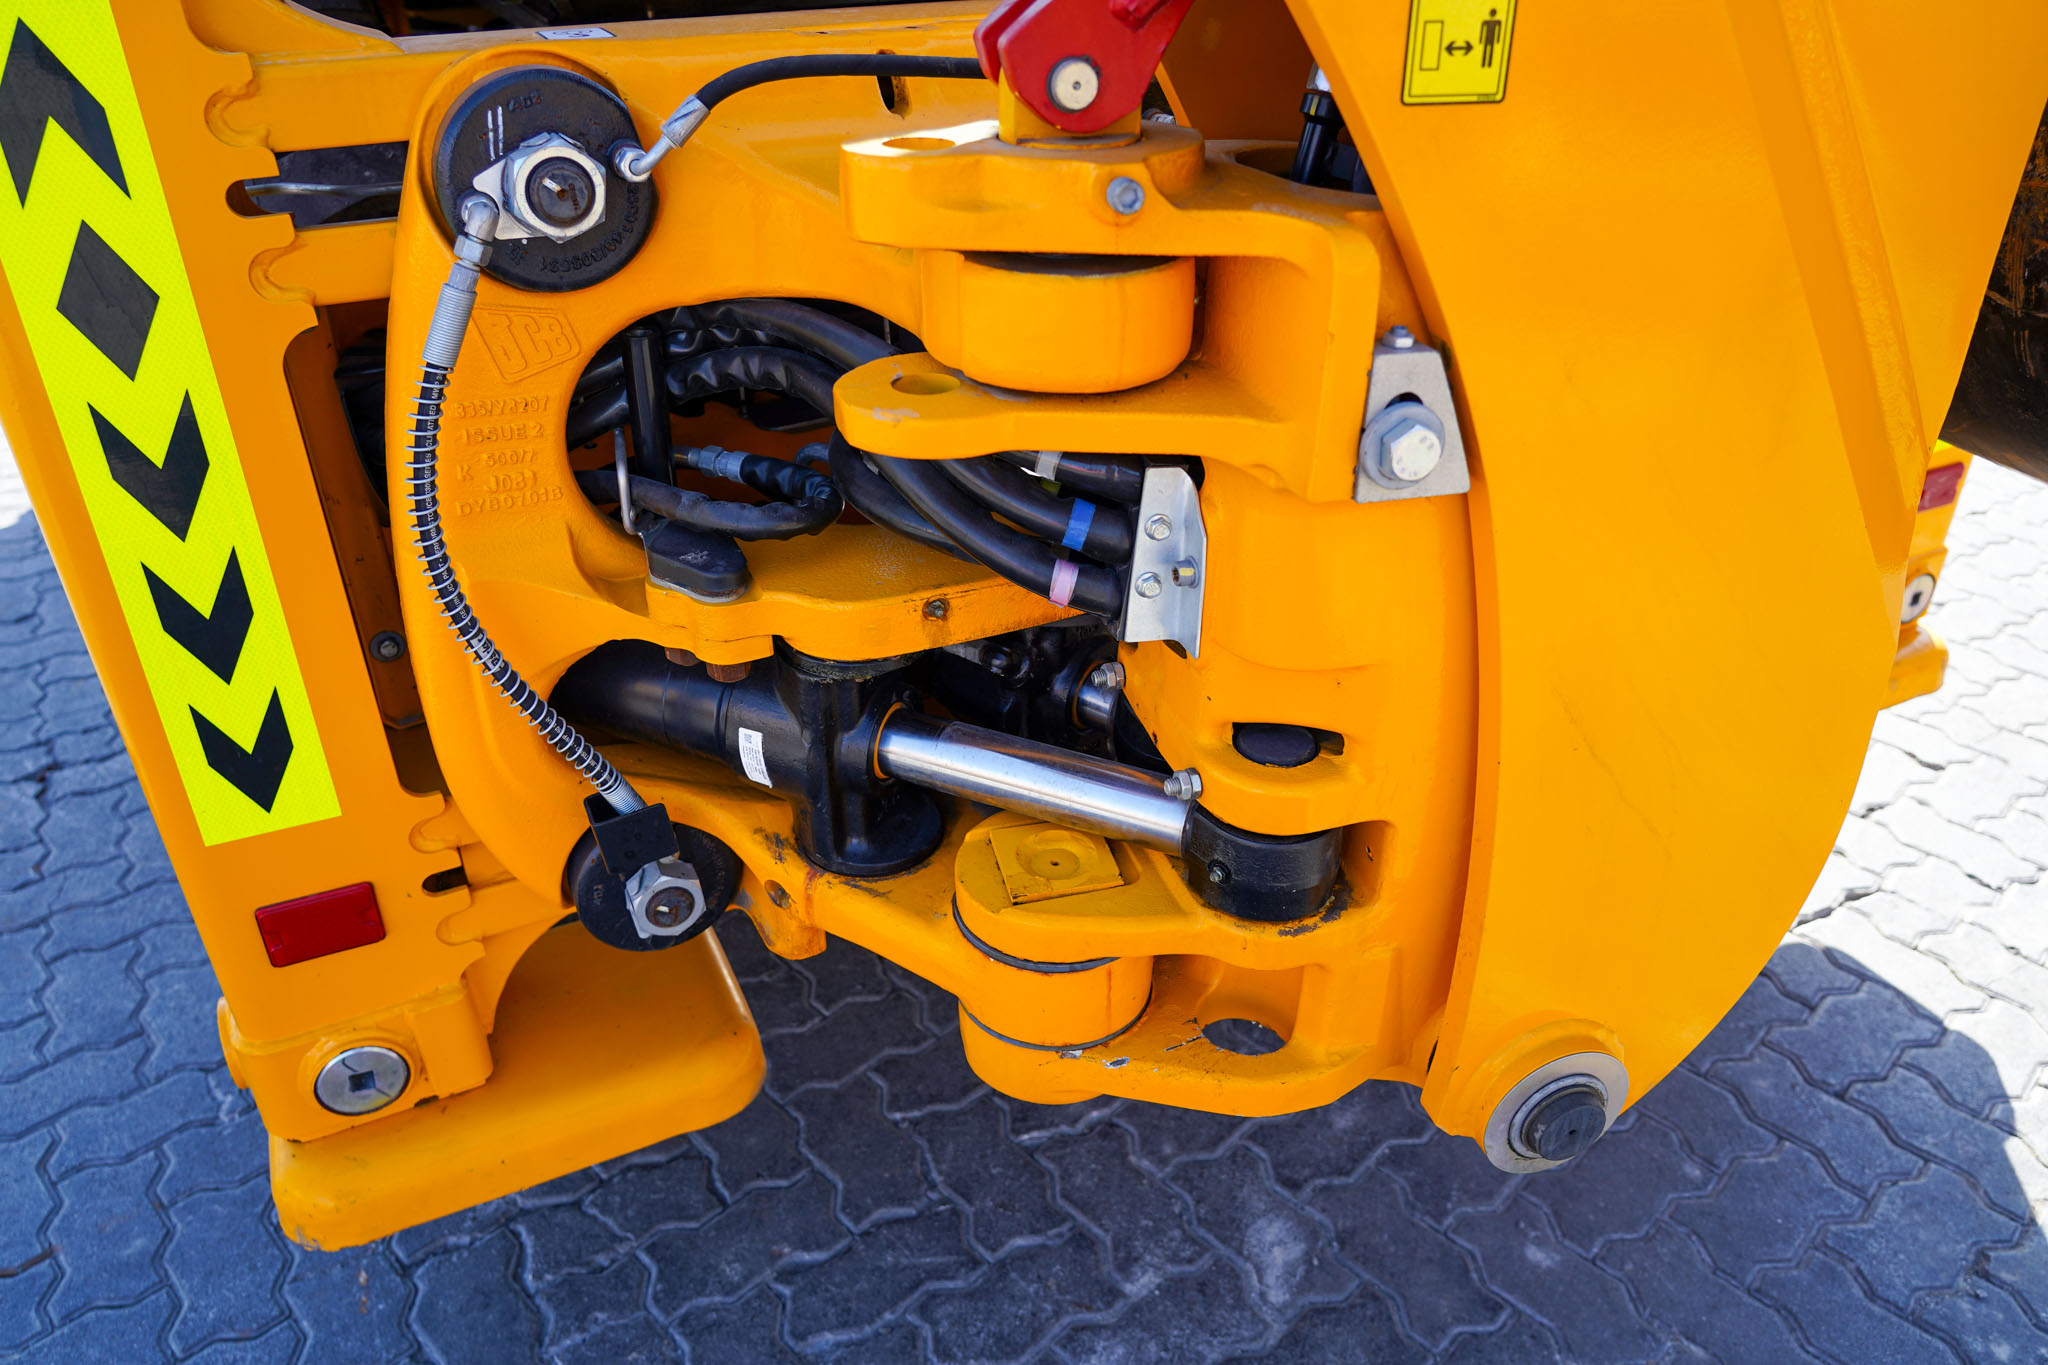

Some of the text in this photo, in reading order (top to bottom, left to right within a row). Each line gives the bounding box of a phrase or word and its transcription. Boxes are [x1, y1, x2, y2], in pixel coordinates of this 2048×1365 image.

[483, 311, 572, 375] JCB
[463, 422, 544, 445] ISSUE 2
[456, 464, 474, 481] K
